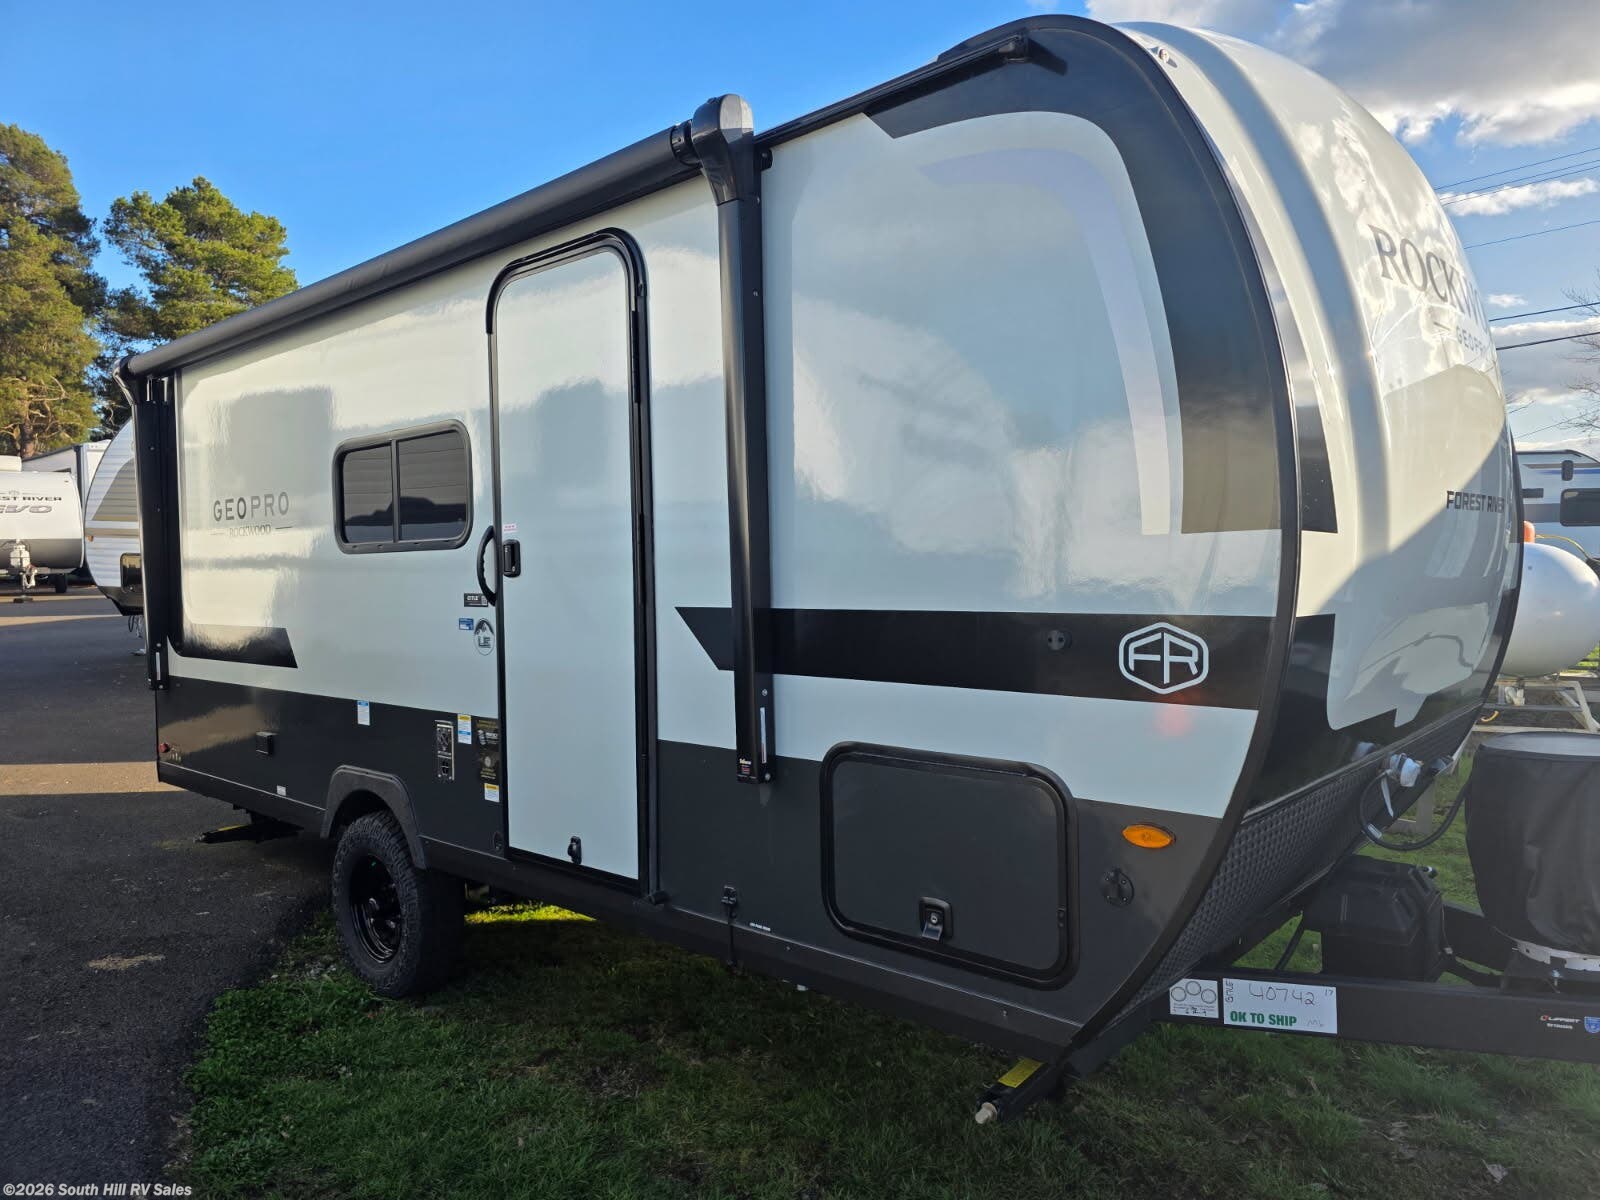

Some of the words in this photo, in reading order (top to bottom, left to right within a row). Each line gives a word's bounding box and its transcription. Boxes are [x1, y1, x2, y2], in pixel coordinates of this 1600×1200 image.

[213, 491, 288, 522] GEOPRO
[1446, 490, 1486, 512] FOREST
[229, 524, 272, 537] ROCKWOOD
[1248, 983, 1315, 1006] 40742
[1230, 1010, 1247, 1022] OK
[1250, 1012, 1265, 1024] TO
[1268, 1014, 1297, 1027] SHIP
